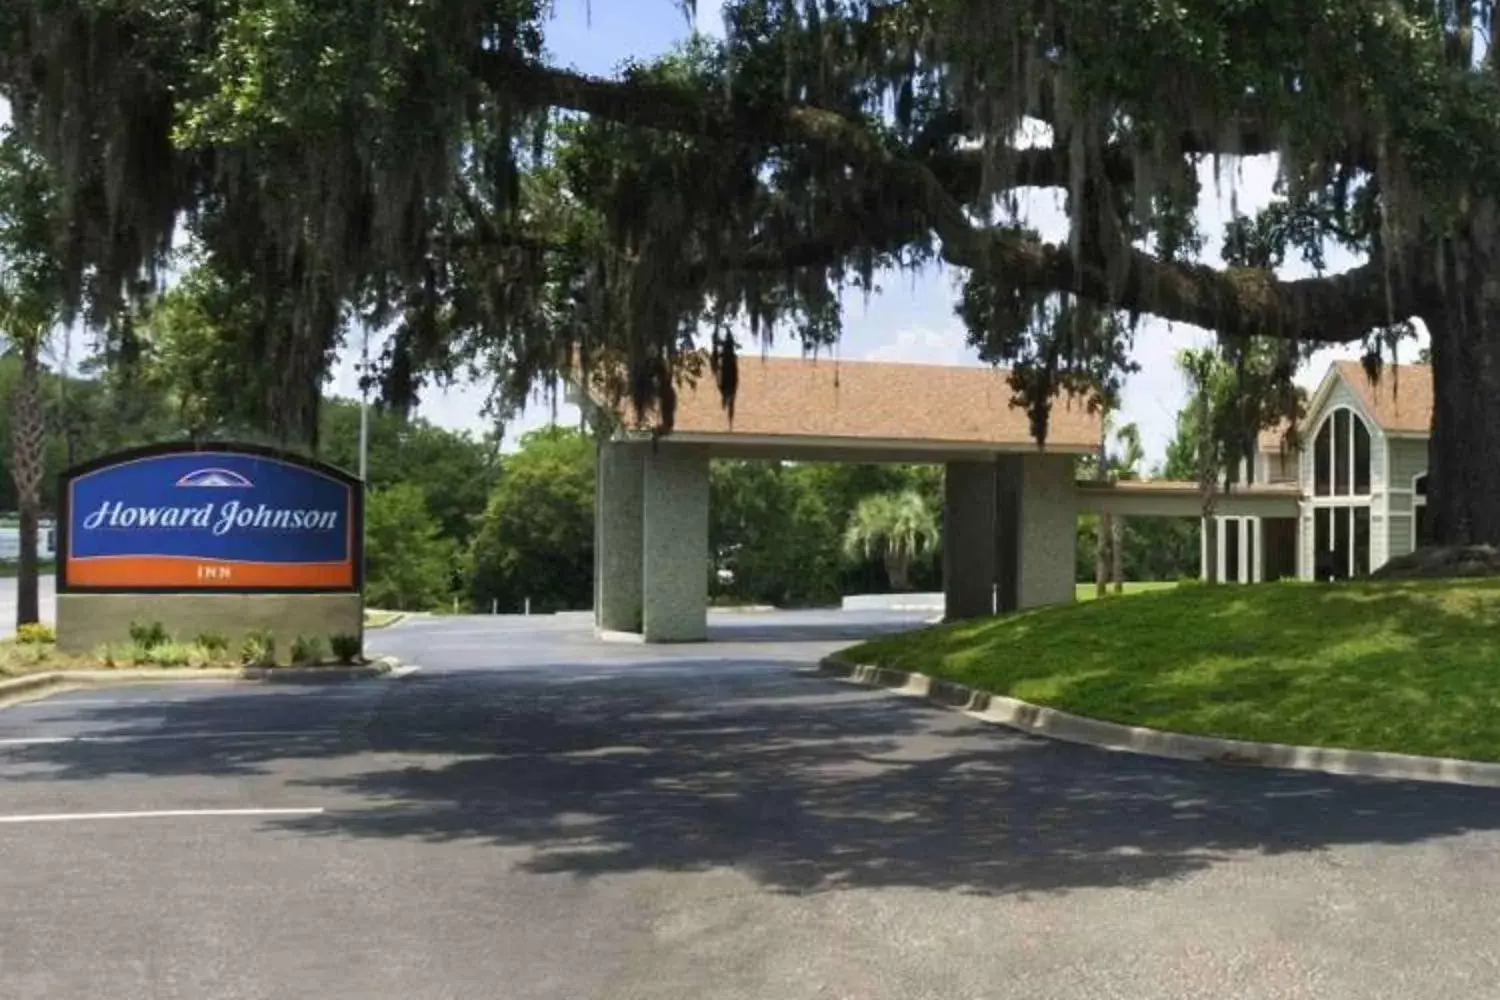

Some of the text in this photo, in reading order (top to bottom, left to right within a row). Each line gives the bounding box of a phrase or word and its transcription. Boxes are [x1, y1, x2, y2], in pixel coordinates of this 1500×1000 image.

[83, 500, 337, 536] Howard Johnson
[197, 566, 231, 579] INN
